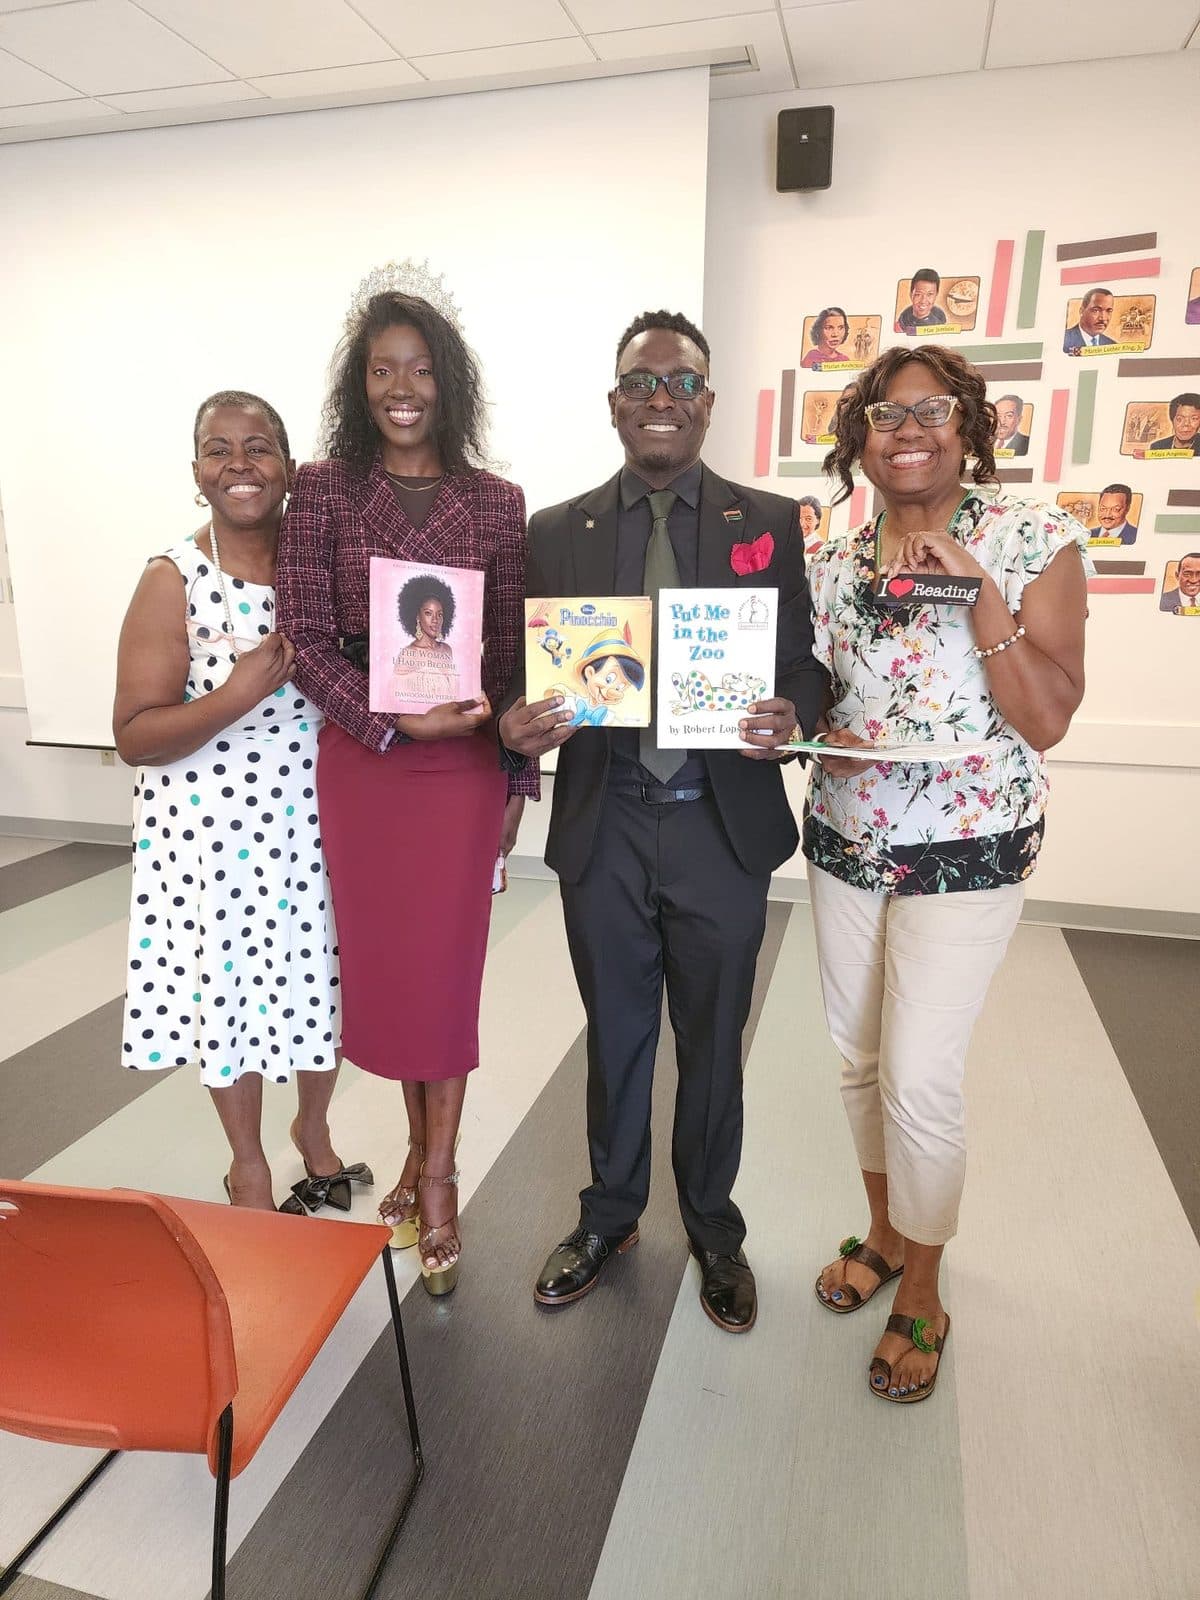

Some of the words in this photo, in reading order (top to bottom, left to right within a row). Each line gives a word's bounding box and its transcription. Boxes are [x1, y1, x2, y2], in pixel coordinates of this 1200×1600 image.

[878, 578, 891, 597] I
[912, 583, 979, 602] Reading
[560, 608, 618, 626] Pinocchio
[668, 603, 701, 622] Put
[704, 604, 731, 620] Me
[672, 623, 692, 640] in
[696, 626, 729, 643] the
[398, 657, 415, 666] HAD
[419, 649, 451, 661] WOMAN
[689, 645, 725, 661] Zoo
[669, 724, 680, 736] by
[683, 724, 716, 735] Robert
